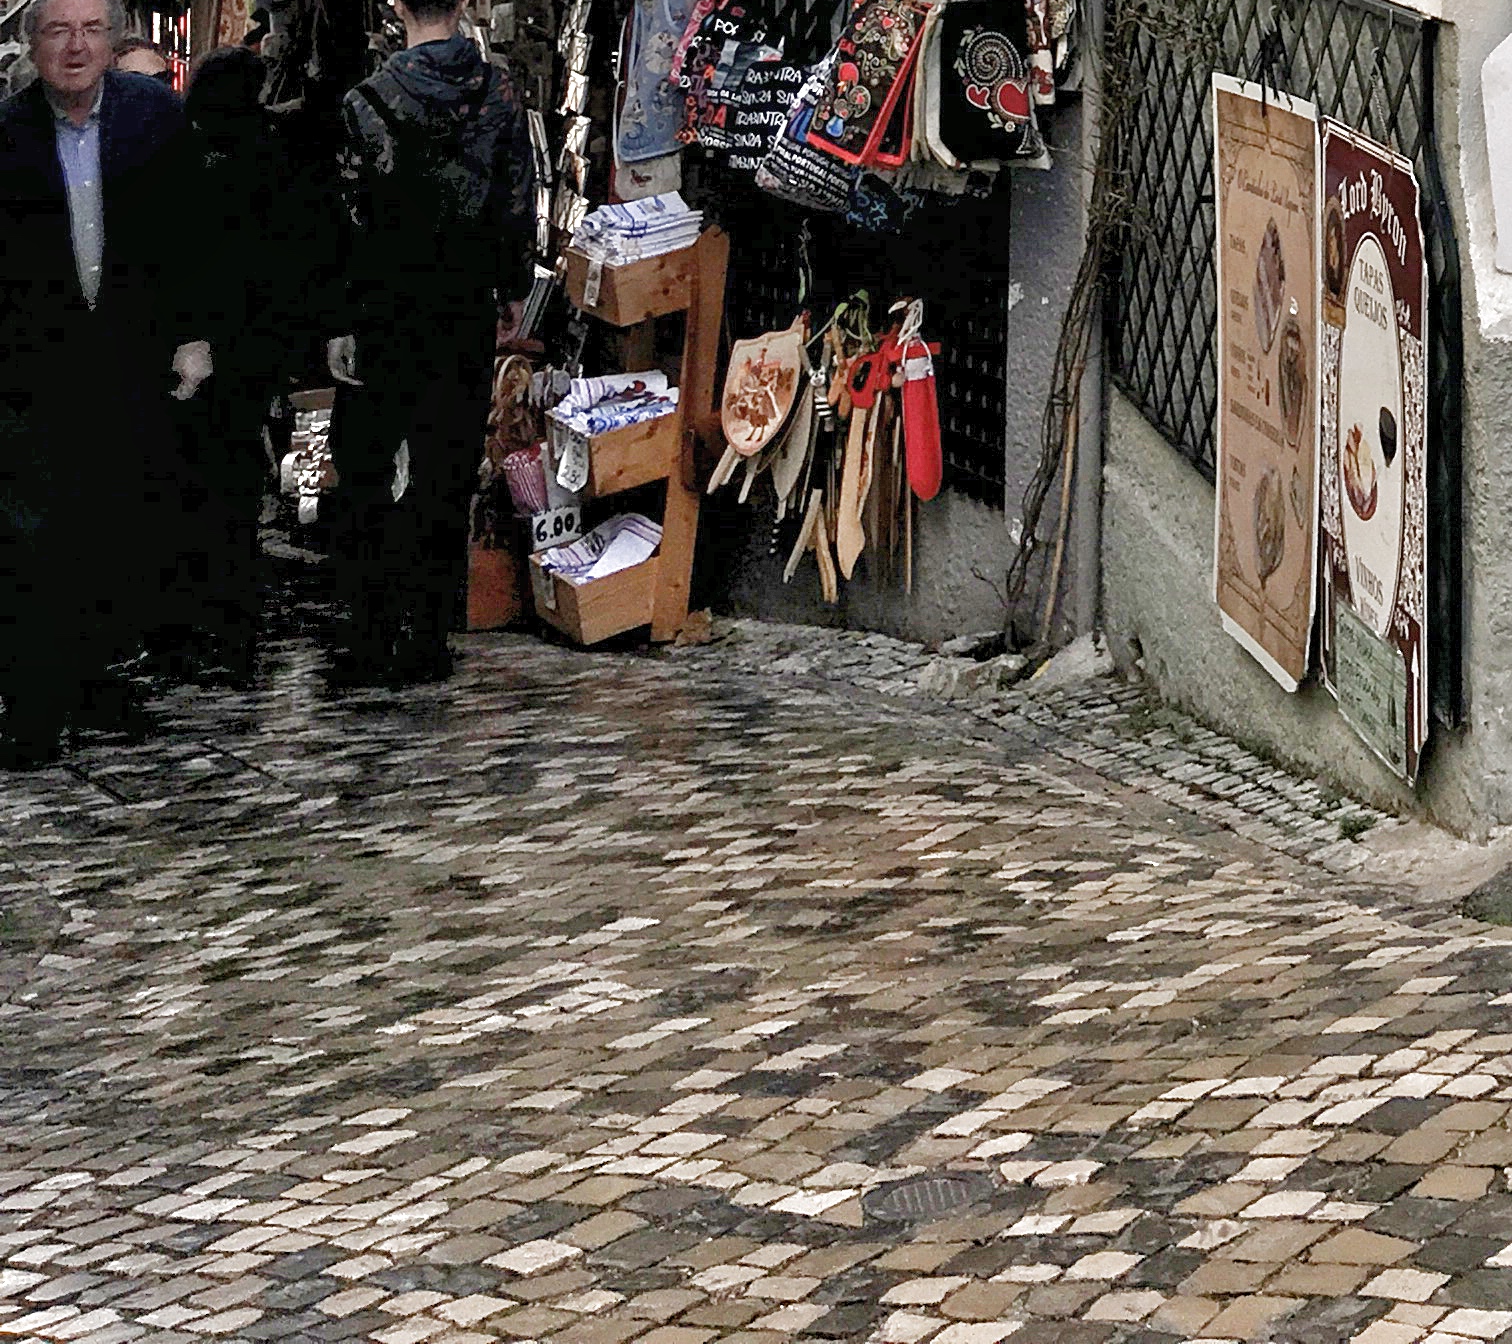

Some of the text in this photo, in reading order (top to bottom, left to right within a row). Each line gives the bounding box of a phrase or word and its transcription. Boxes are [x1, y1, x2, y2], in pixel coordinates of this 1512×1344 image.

[1338, 168, 1407, 266] Lord Byron
[1358, 258, 1385, 296] TAPAS
[1353, 286, 1388, 331] QUEIJOS
[535, 512, 575, 543] 6.00
[1354, 555, 1384, 607] VINHOS
